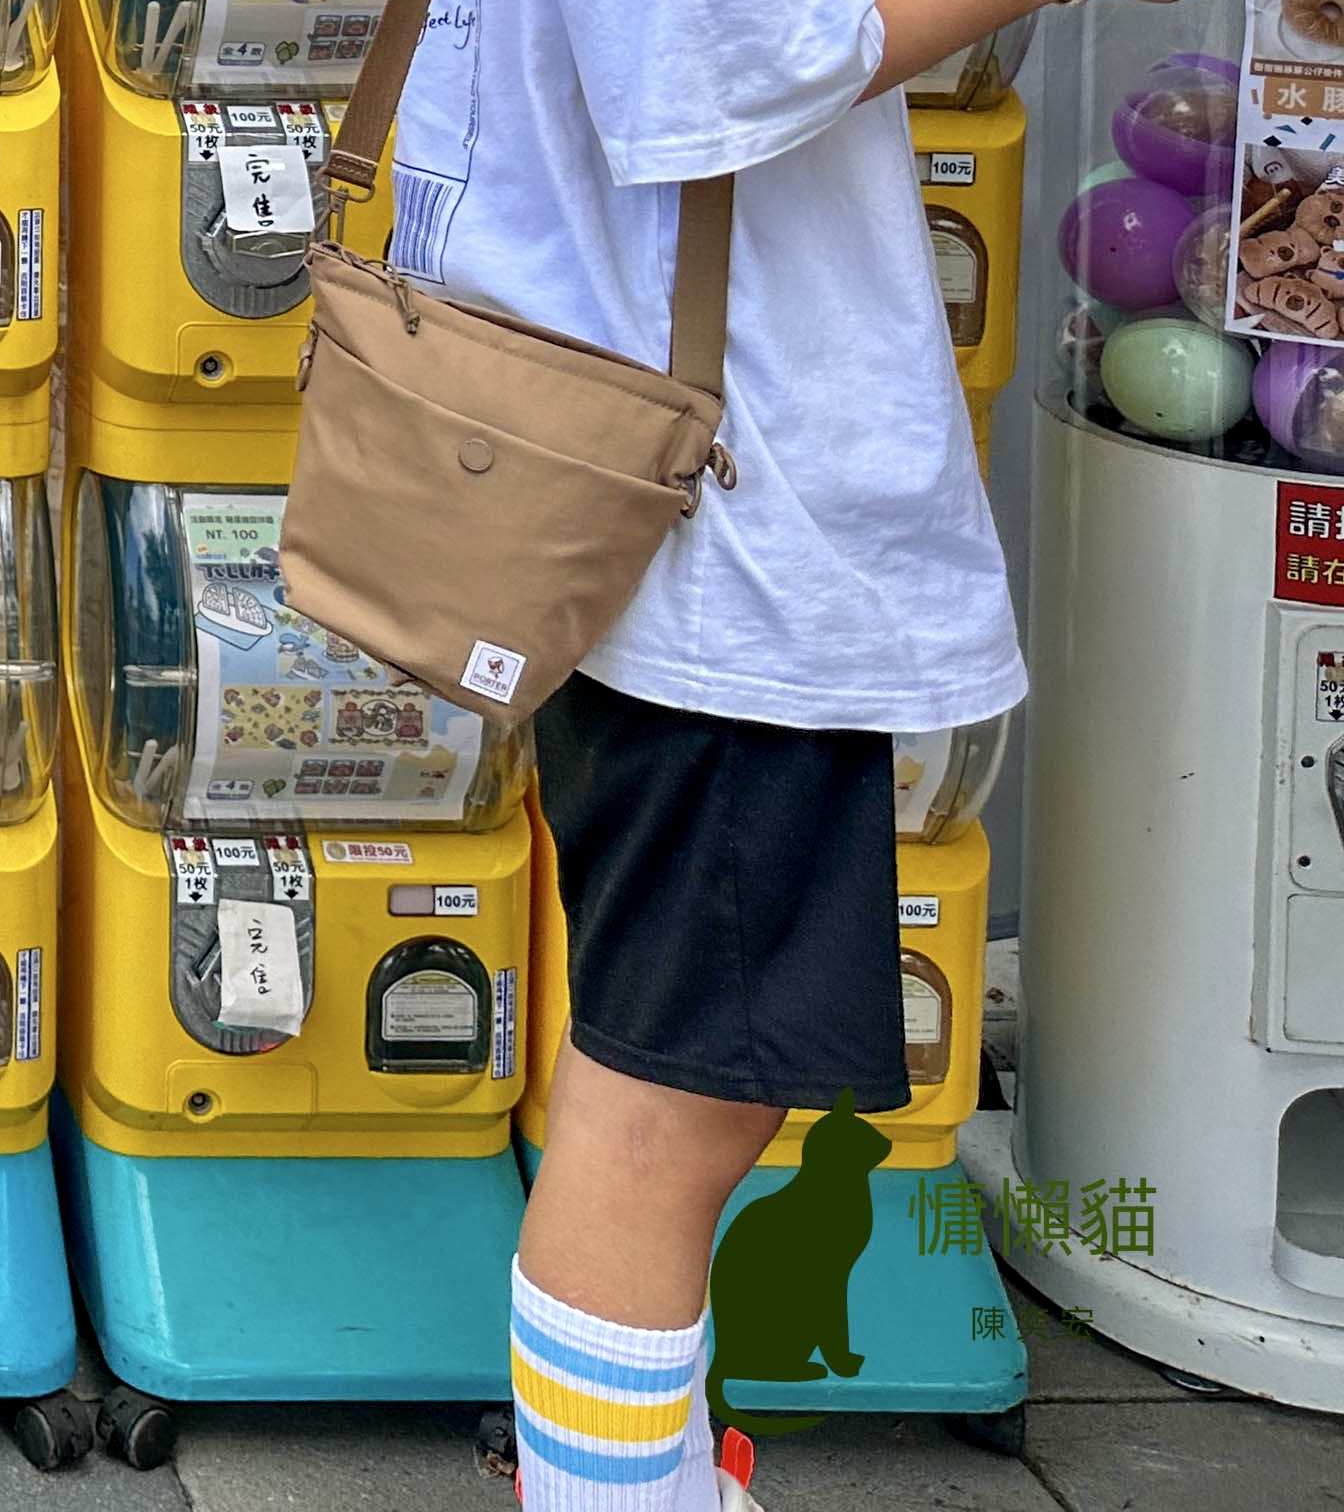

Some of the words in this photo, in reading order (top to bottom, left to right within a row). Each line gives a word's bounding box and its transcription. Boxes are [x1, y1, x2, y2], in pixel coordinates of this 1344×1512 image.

[231, 112, 272, 123] 100元
[190, 123, 223, 134] 50元
[286, 123, 319, 134] 50元
[196, 136, 219, 149] 1枚
[293, 136, 317, 149] 1枚
[933, 161, 972, 175] 100元
[232, 529, 258, 540] 100
[473, 673, 508, 691] PORTER
[216, 846, 256, 860] 100元
[348, 844, 408, 859] 限投50元
[179, 863, 211, 875] 50元
[273, 862, 305, 874] 50元
[184, 877, 208, 890] 1枚
[280, 876, 303, 889] 1枚
[437, 894, 476, 909] 100元
[899, 903, 937, 918] 100元
